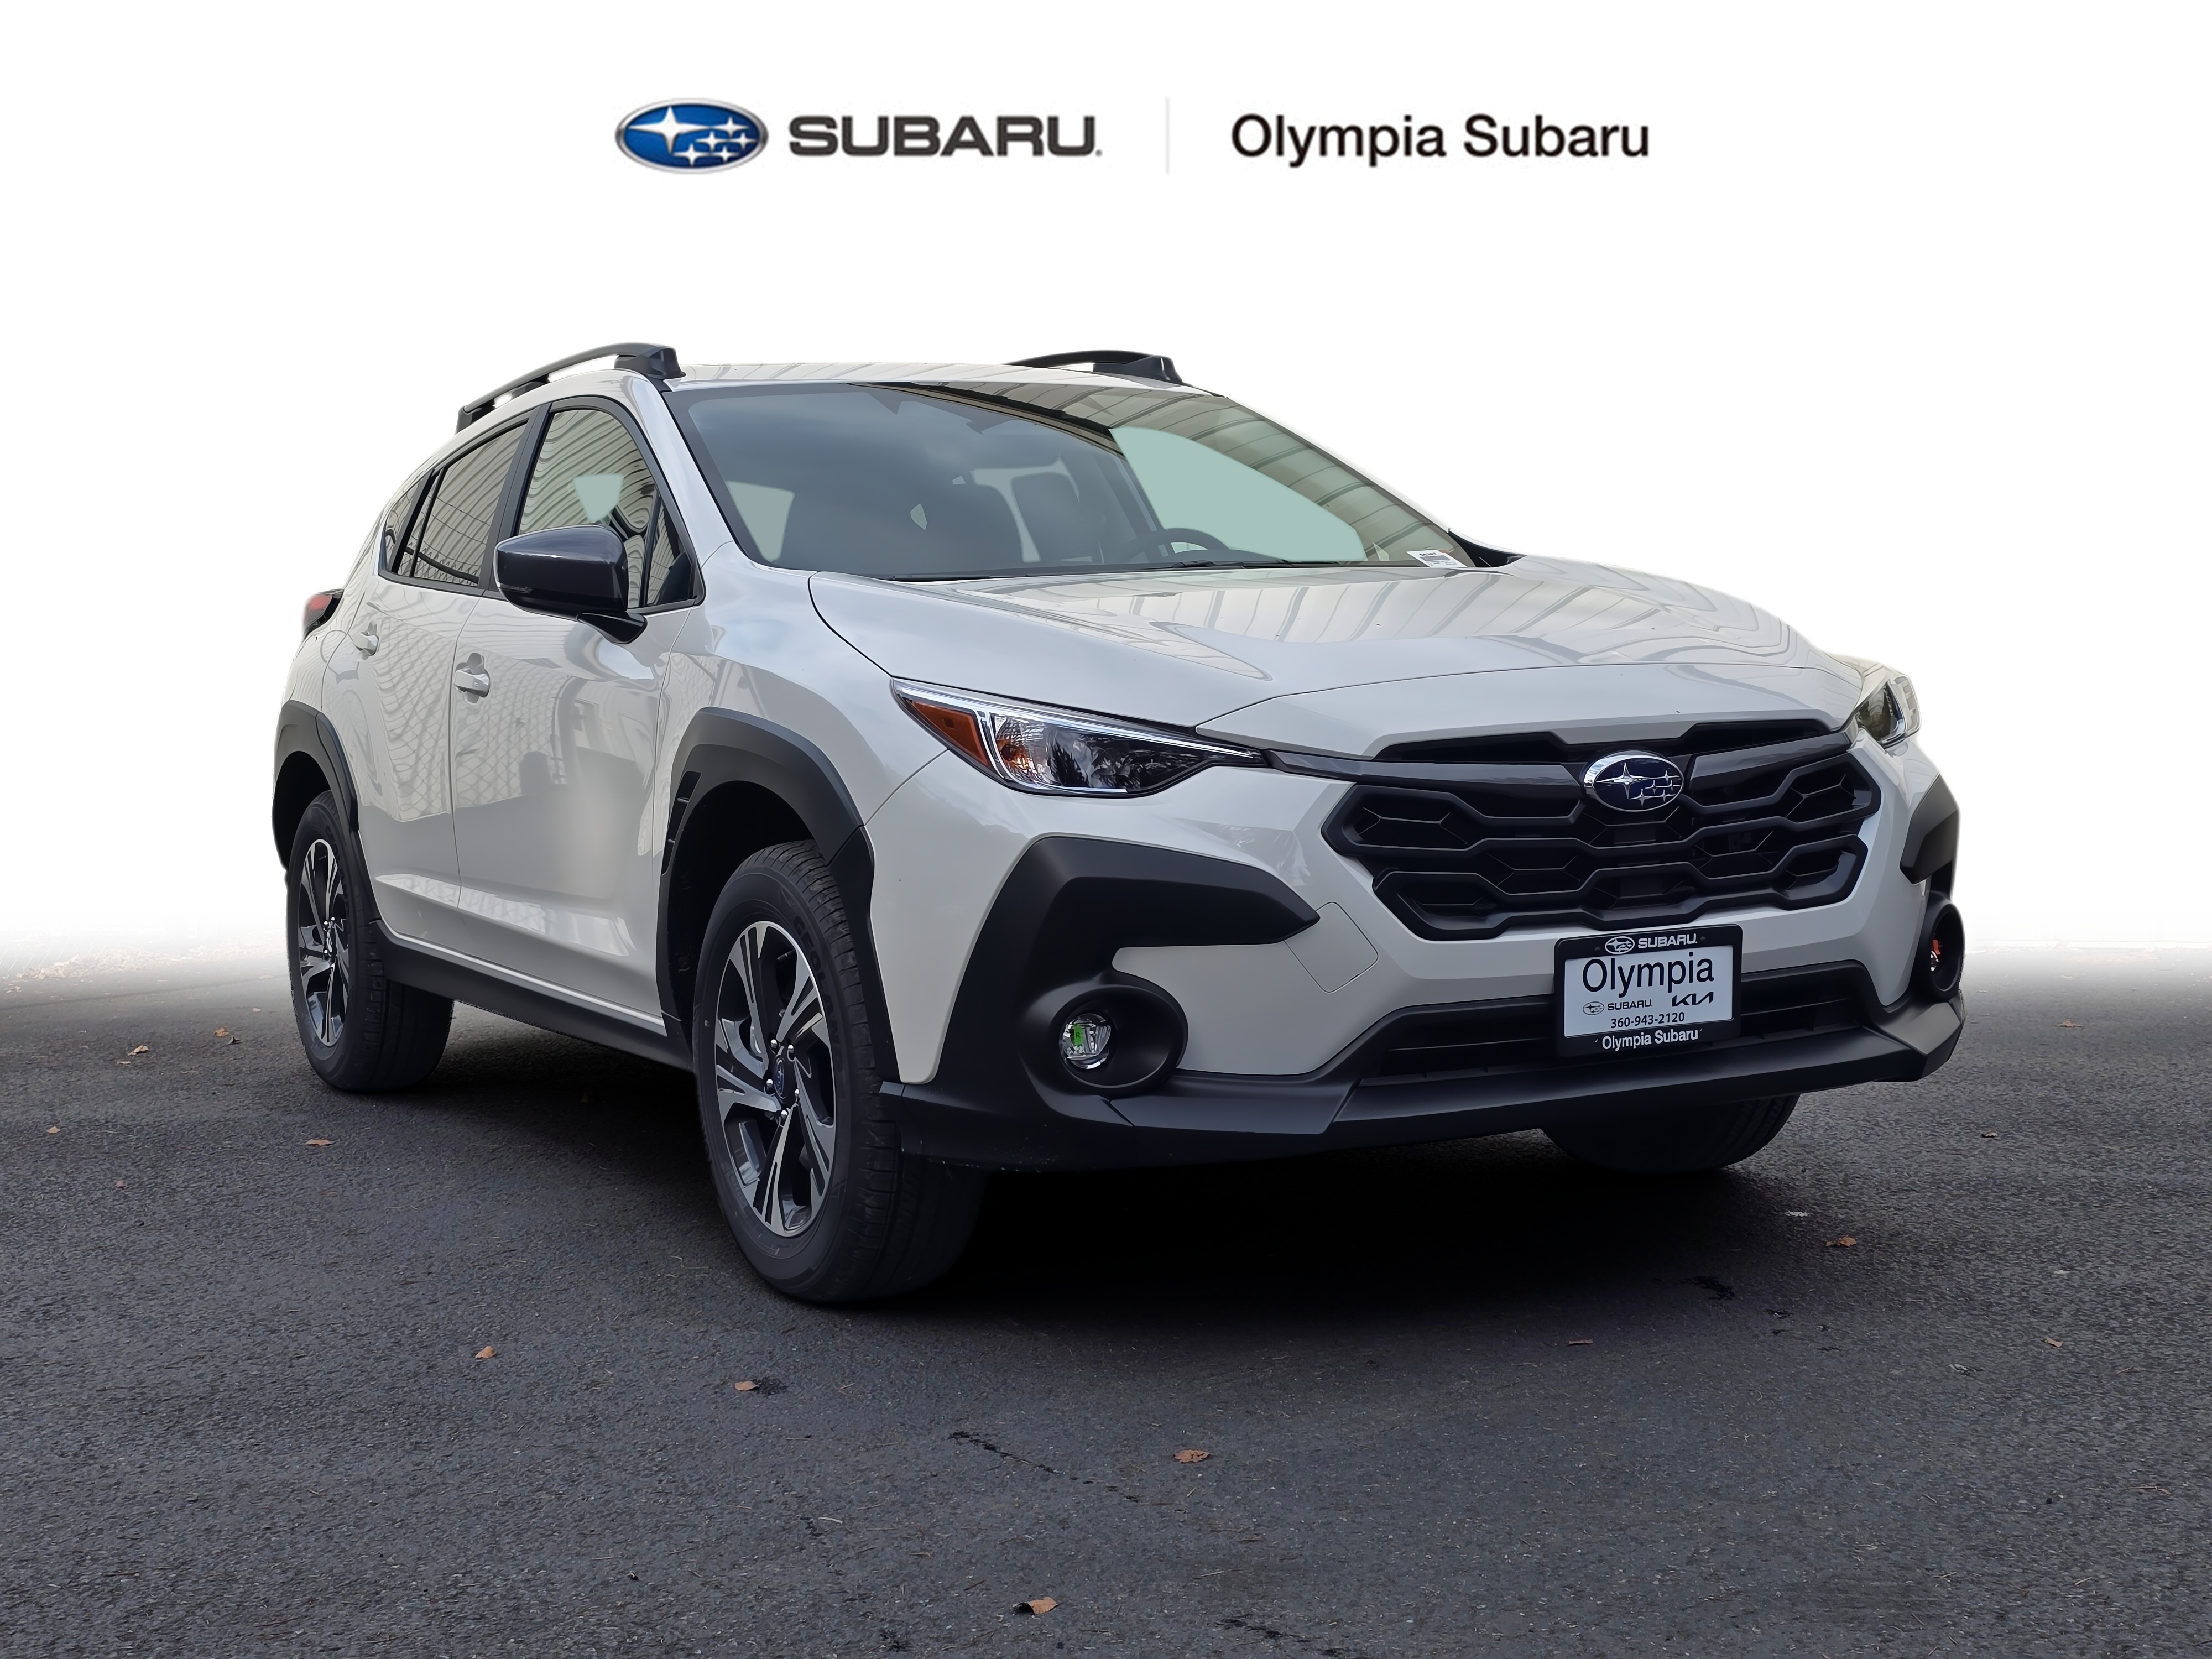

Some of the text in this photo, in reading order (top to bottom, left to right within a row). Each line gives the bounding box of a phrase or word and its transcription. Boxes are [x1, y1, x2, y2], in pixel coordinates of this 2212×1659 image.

[1637, 933, 1697, 949] SUBARU
[1582, 951, 1714, 998] Olympia
[1607, 999, 1652, 1011] SUBARU
[1610, 1011, 1685, 1029] 360-943-2120
[1602, 1029, 1698, 1051] Olympia Subaru
